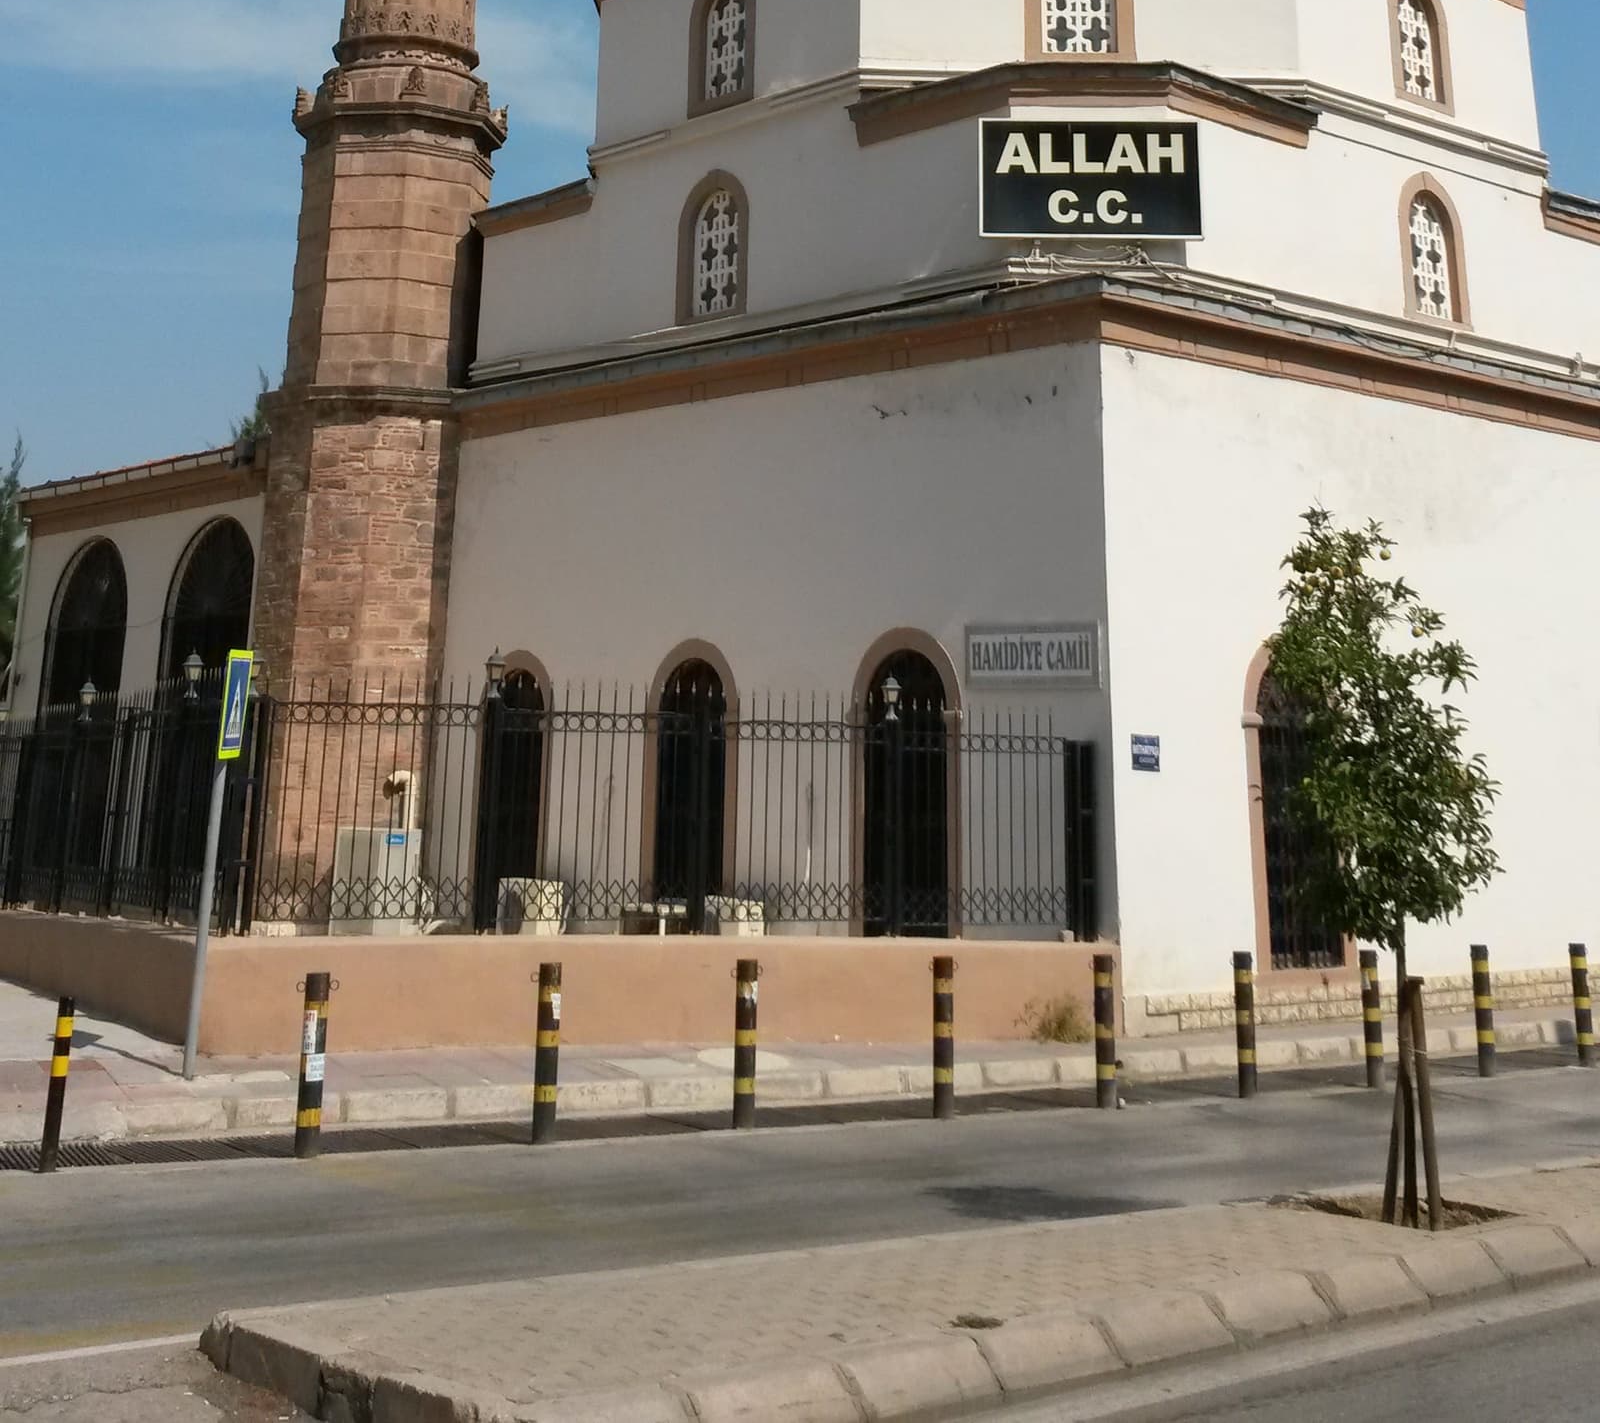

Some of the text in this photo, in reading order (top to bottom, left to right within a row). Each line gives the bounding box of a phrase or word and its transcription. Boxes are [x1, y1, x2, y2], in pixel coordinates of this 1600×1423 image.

[995, 132, 1185, 174] ALLAH
[1047, 189, 1143, 224] C.C.
[971, 634, 1090, 671] HAMİDİYE CAMİİ
